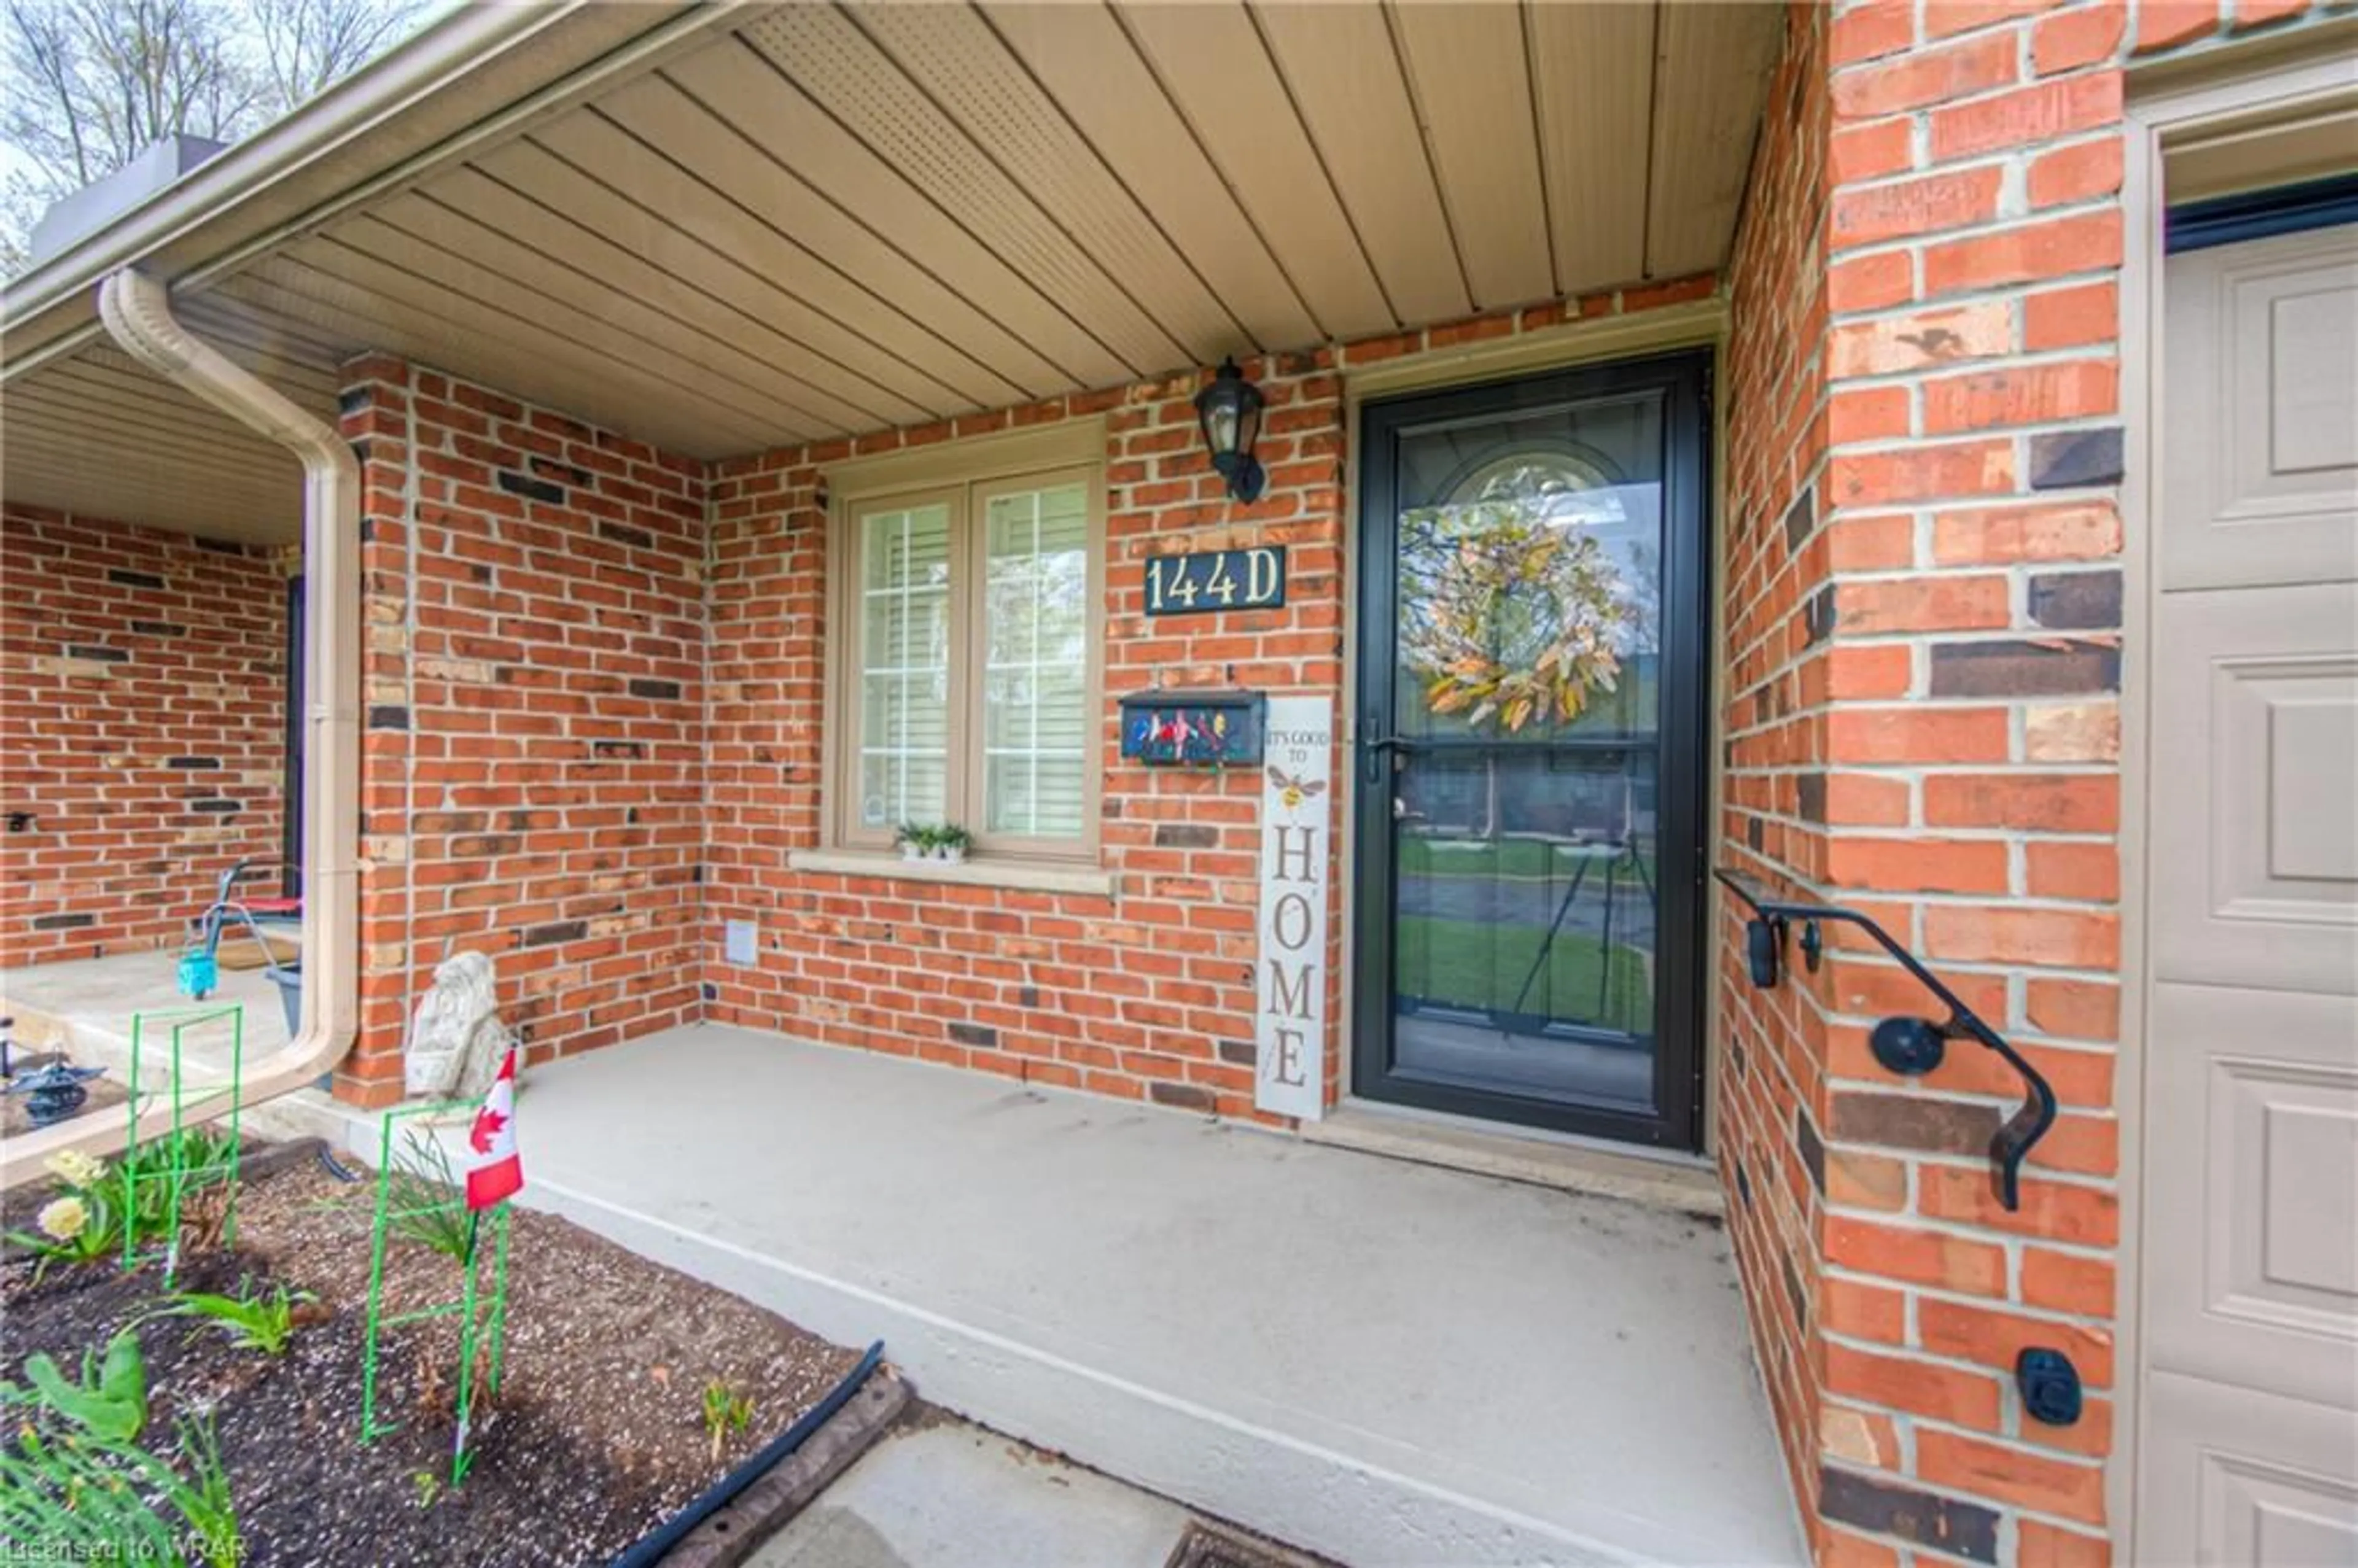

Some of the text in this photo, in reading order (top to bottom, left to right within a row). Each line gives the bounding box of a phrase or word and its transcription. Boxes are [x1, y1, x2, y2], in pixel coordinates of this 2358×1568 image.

[1147, 548, 1278, 609] 144D
[1288, 748, 1307, 763] TO
[1291, 729, 1331, 746] GOOD
[1267, 825, 1318, 1087] HOME
